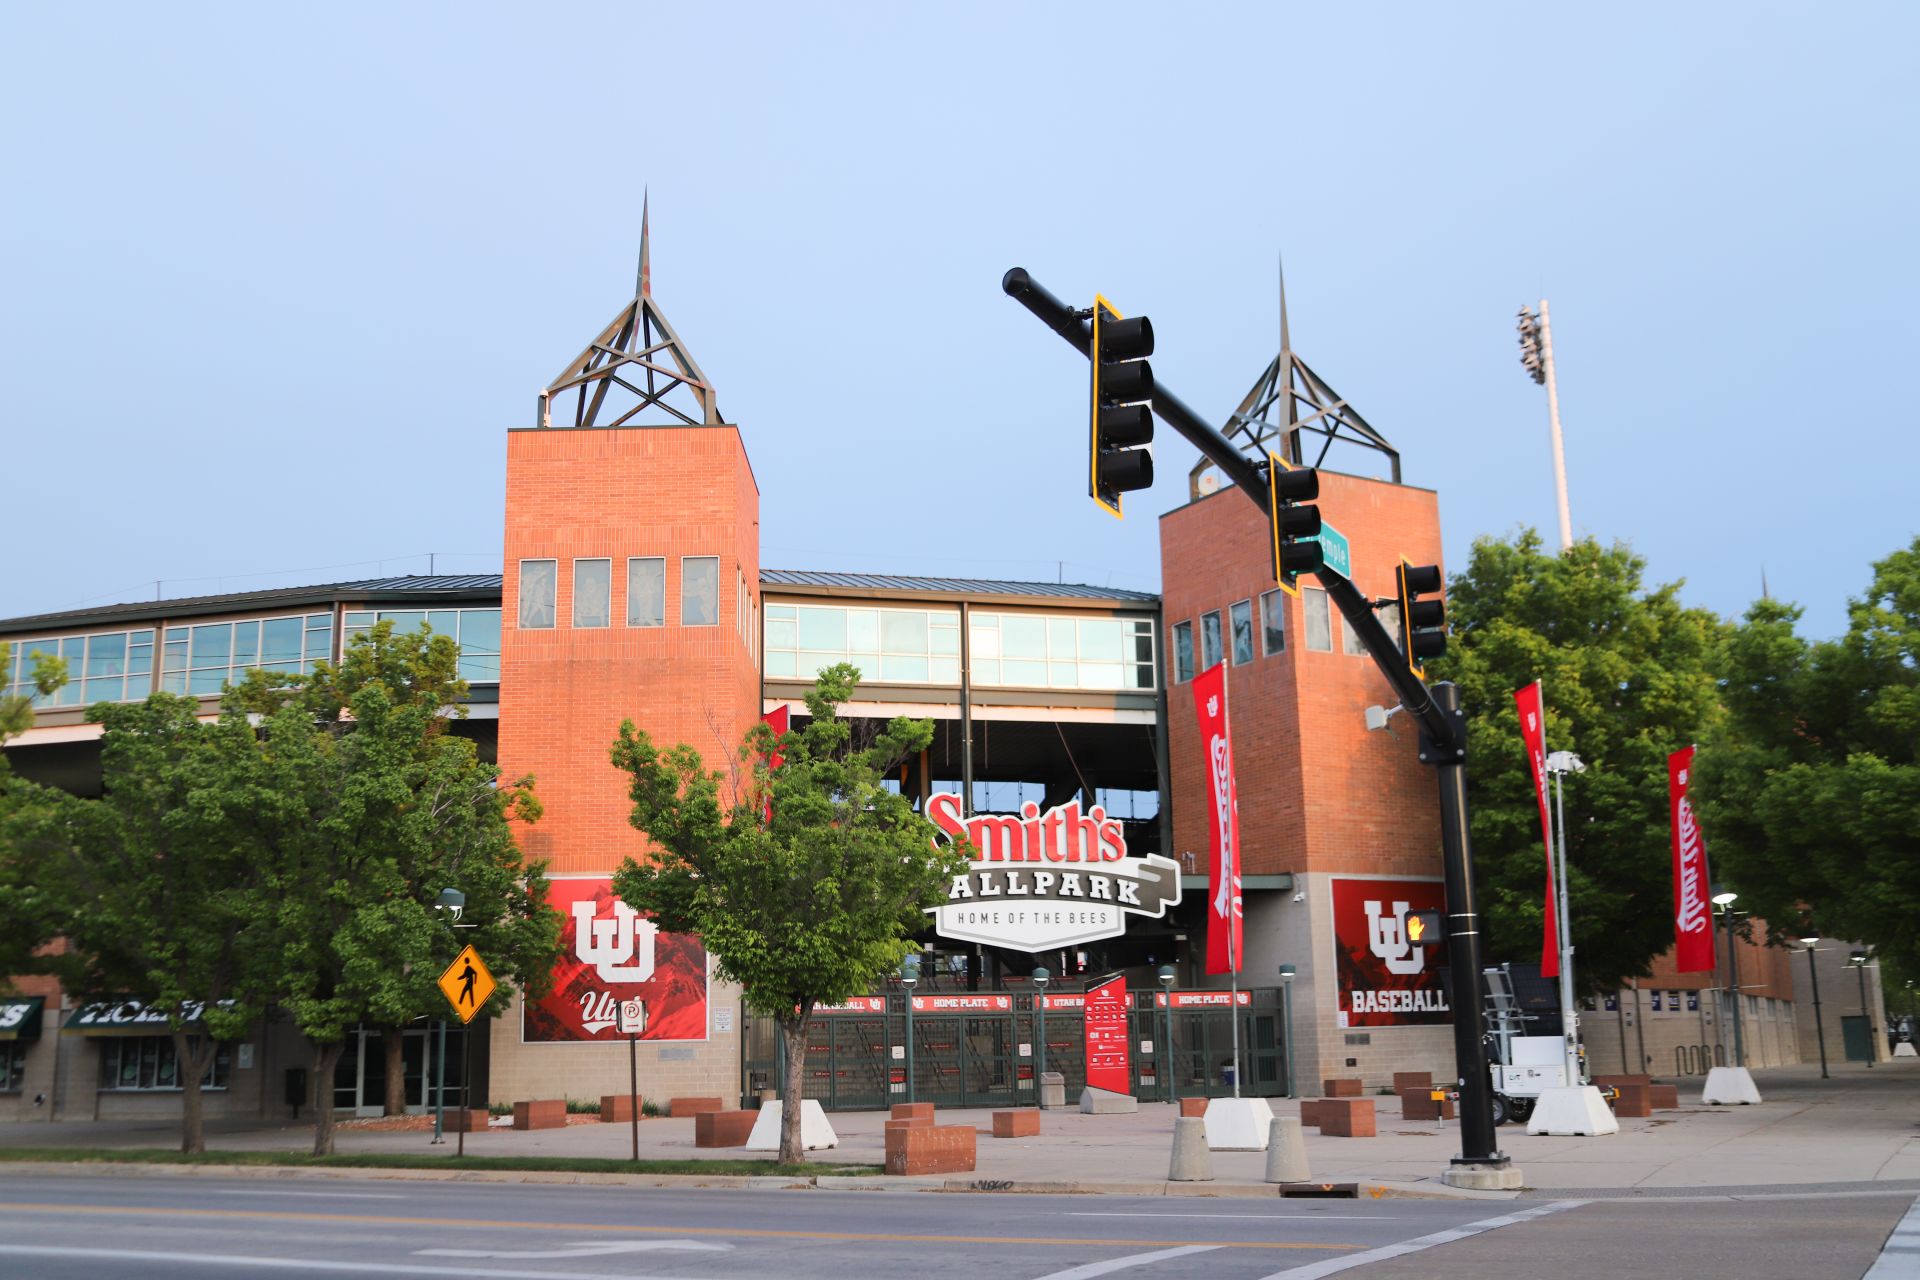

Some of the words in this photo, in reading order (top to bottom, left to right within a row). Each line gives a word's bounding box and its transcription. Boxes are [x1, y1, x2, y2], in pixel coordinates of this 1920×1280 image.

[1319, 535, 1346, 566] emple
[928, 793, 1123, 862] Smith's
[948, 870, 1142, 906] ALLPARK
[957, 912, 999, 924] HOME
[1008, 912, 1025, 924] OF
[1034, 912, 1064, 924] THE
[1069, 912, 1106, 924] BEES
[933, 998, 958, 1008] HOME
[960, 998, 989, 1008] PLATE
[1053, 998, 1075, 1007] UTAH
[1178, 995, 1202, 1004] HOME
[1203, 995, 1230, 1004] PLATE
[1351, 989, 1450, 1013] BASEBALL
[79, 1000, 237, 1024] TICKT
